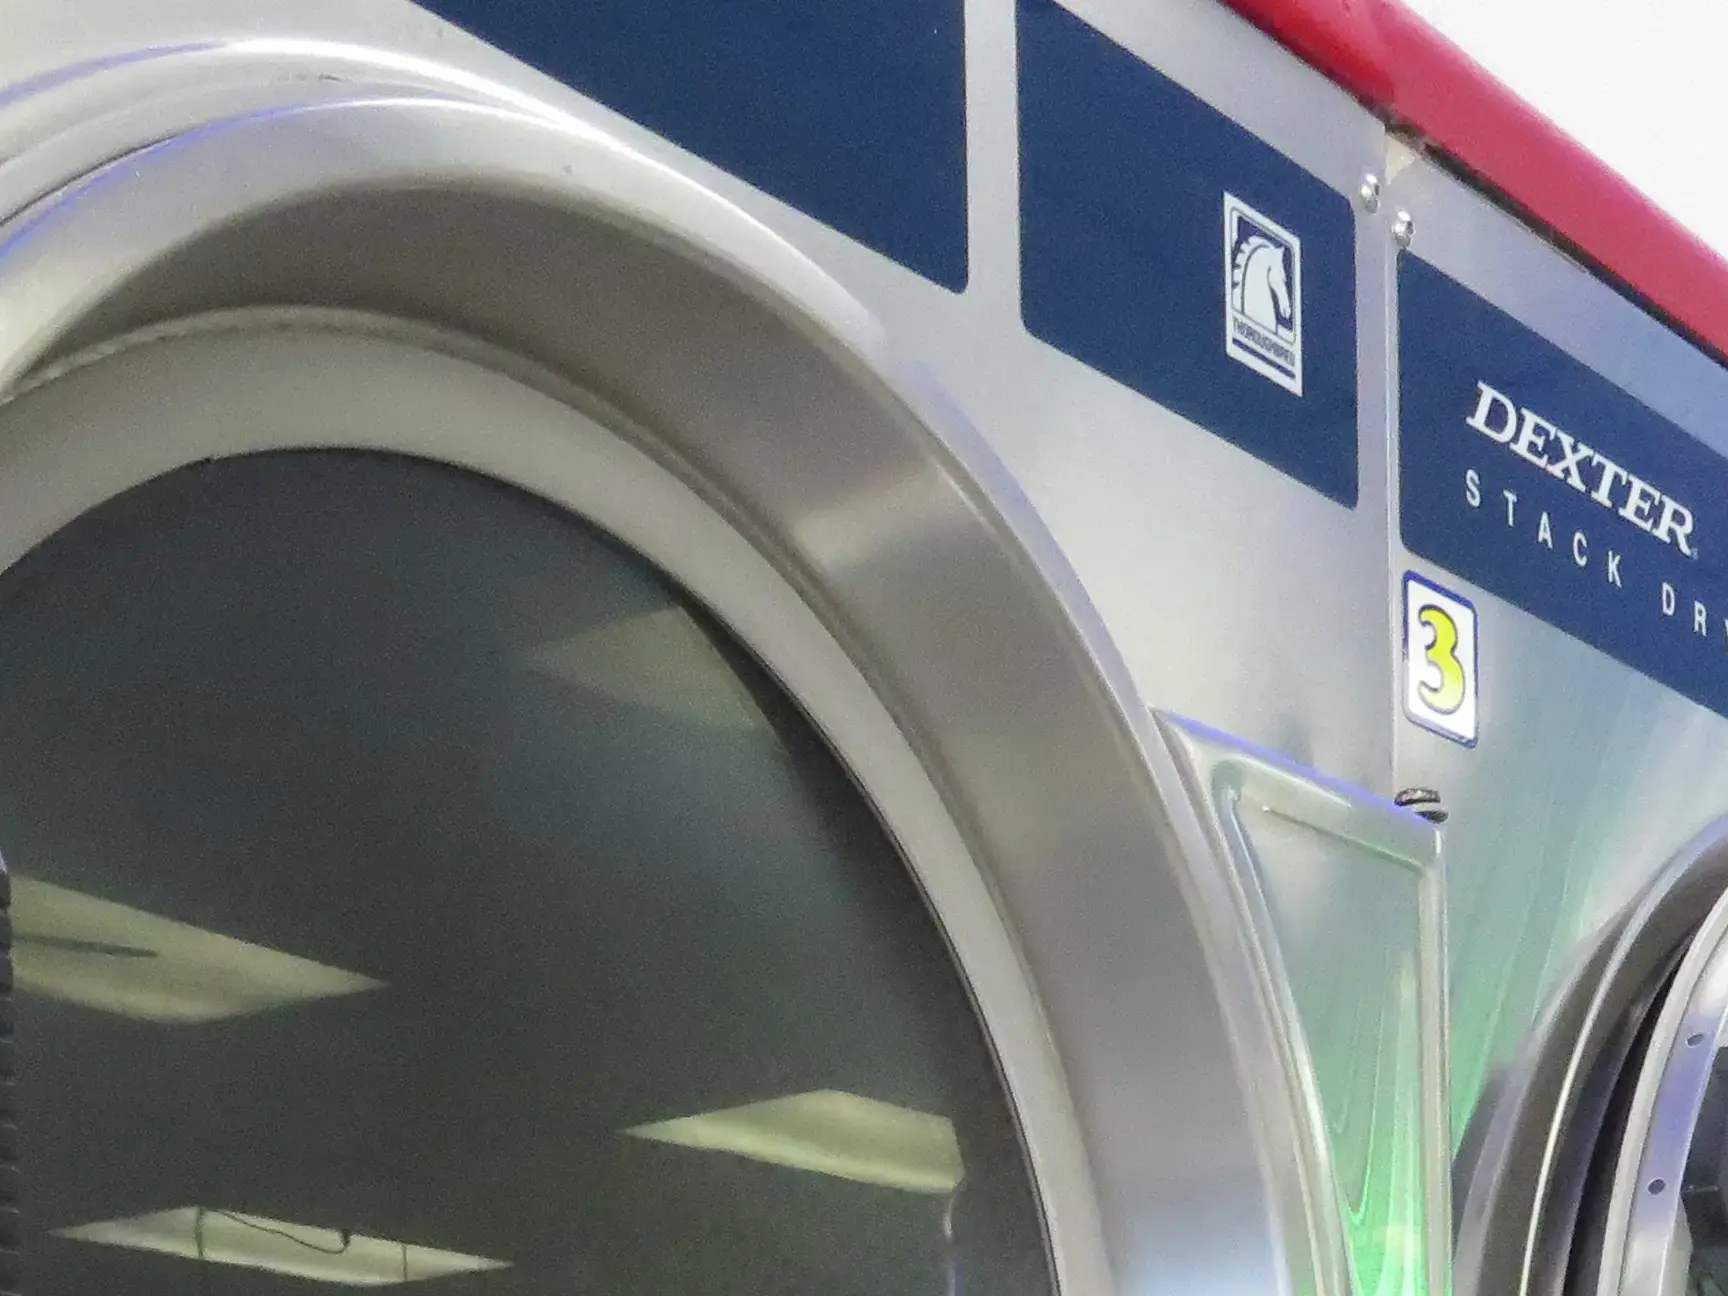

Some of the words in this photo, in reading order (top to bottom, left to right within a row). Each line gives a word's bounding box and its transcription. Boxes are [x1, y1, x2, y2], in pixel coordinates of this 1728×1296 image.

[1465, 380, 1695, 557] DEXTER
[1465, 469, 1621, 588] STACK
[1418, 604, 1465, 715] 3
